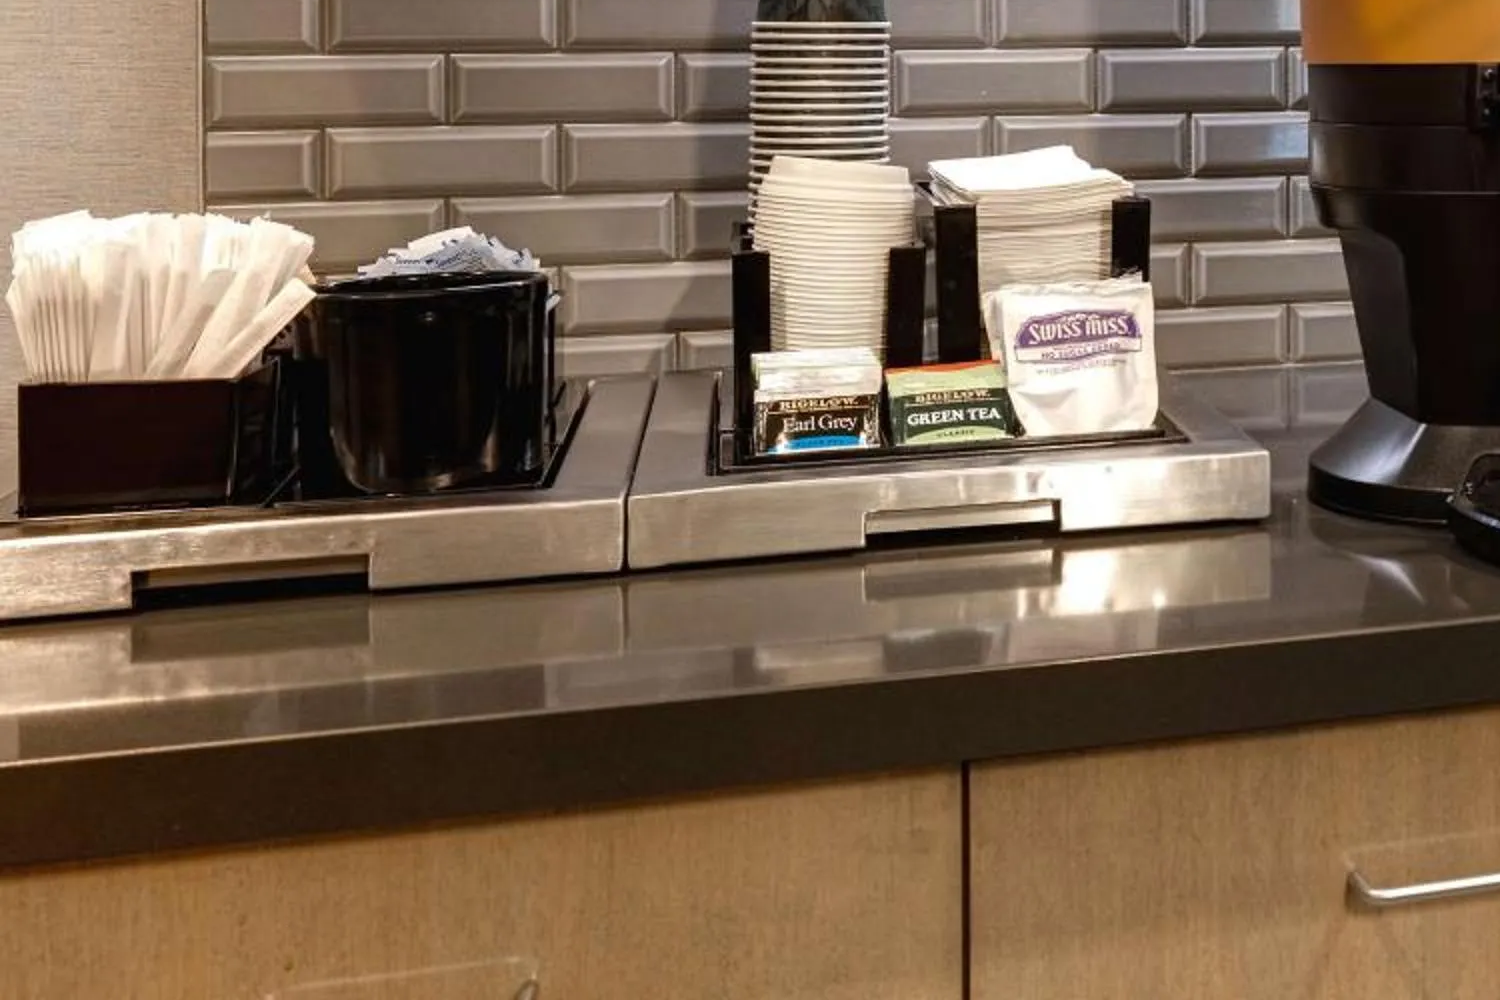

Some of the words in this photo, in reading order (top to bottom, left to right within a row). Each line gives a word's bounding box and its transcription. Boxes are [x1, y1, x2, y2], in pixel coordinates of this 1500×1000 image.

[783, 415, 816, 433] Earl
[819, 413, 857, 431] Grey
[907, 409, 965, 426] GREEN
[966, 407, 1002, 420] TEA
